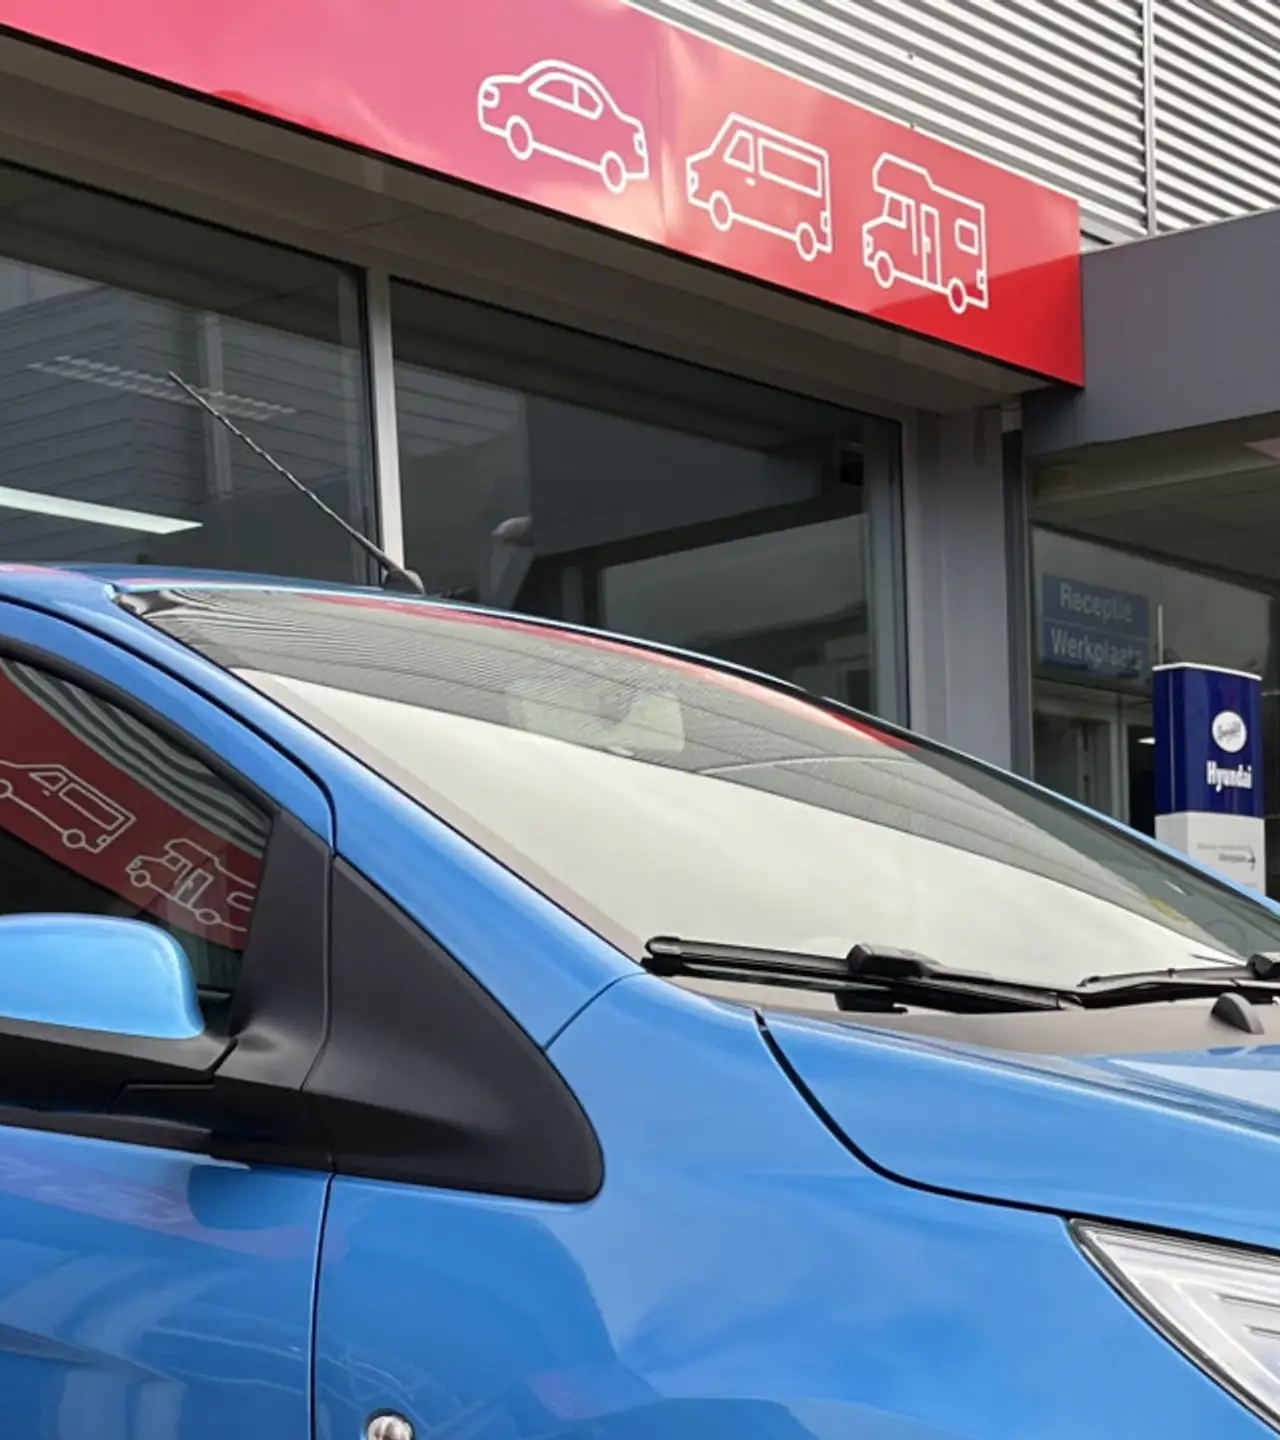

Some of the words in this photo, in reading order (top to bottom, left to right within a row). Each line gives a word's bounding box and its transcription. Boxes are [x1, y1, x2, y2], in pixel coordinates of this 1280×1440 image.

[1058, 581, 1133, 624] Receptie
[1049, 626, 1144, 671] Werkplaats
[1205, 759, 1253, 792] Hyundai
